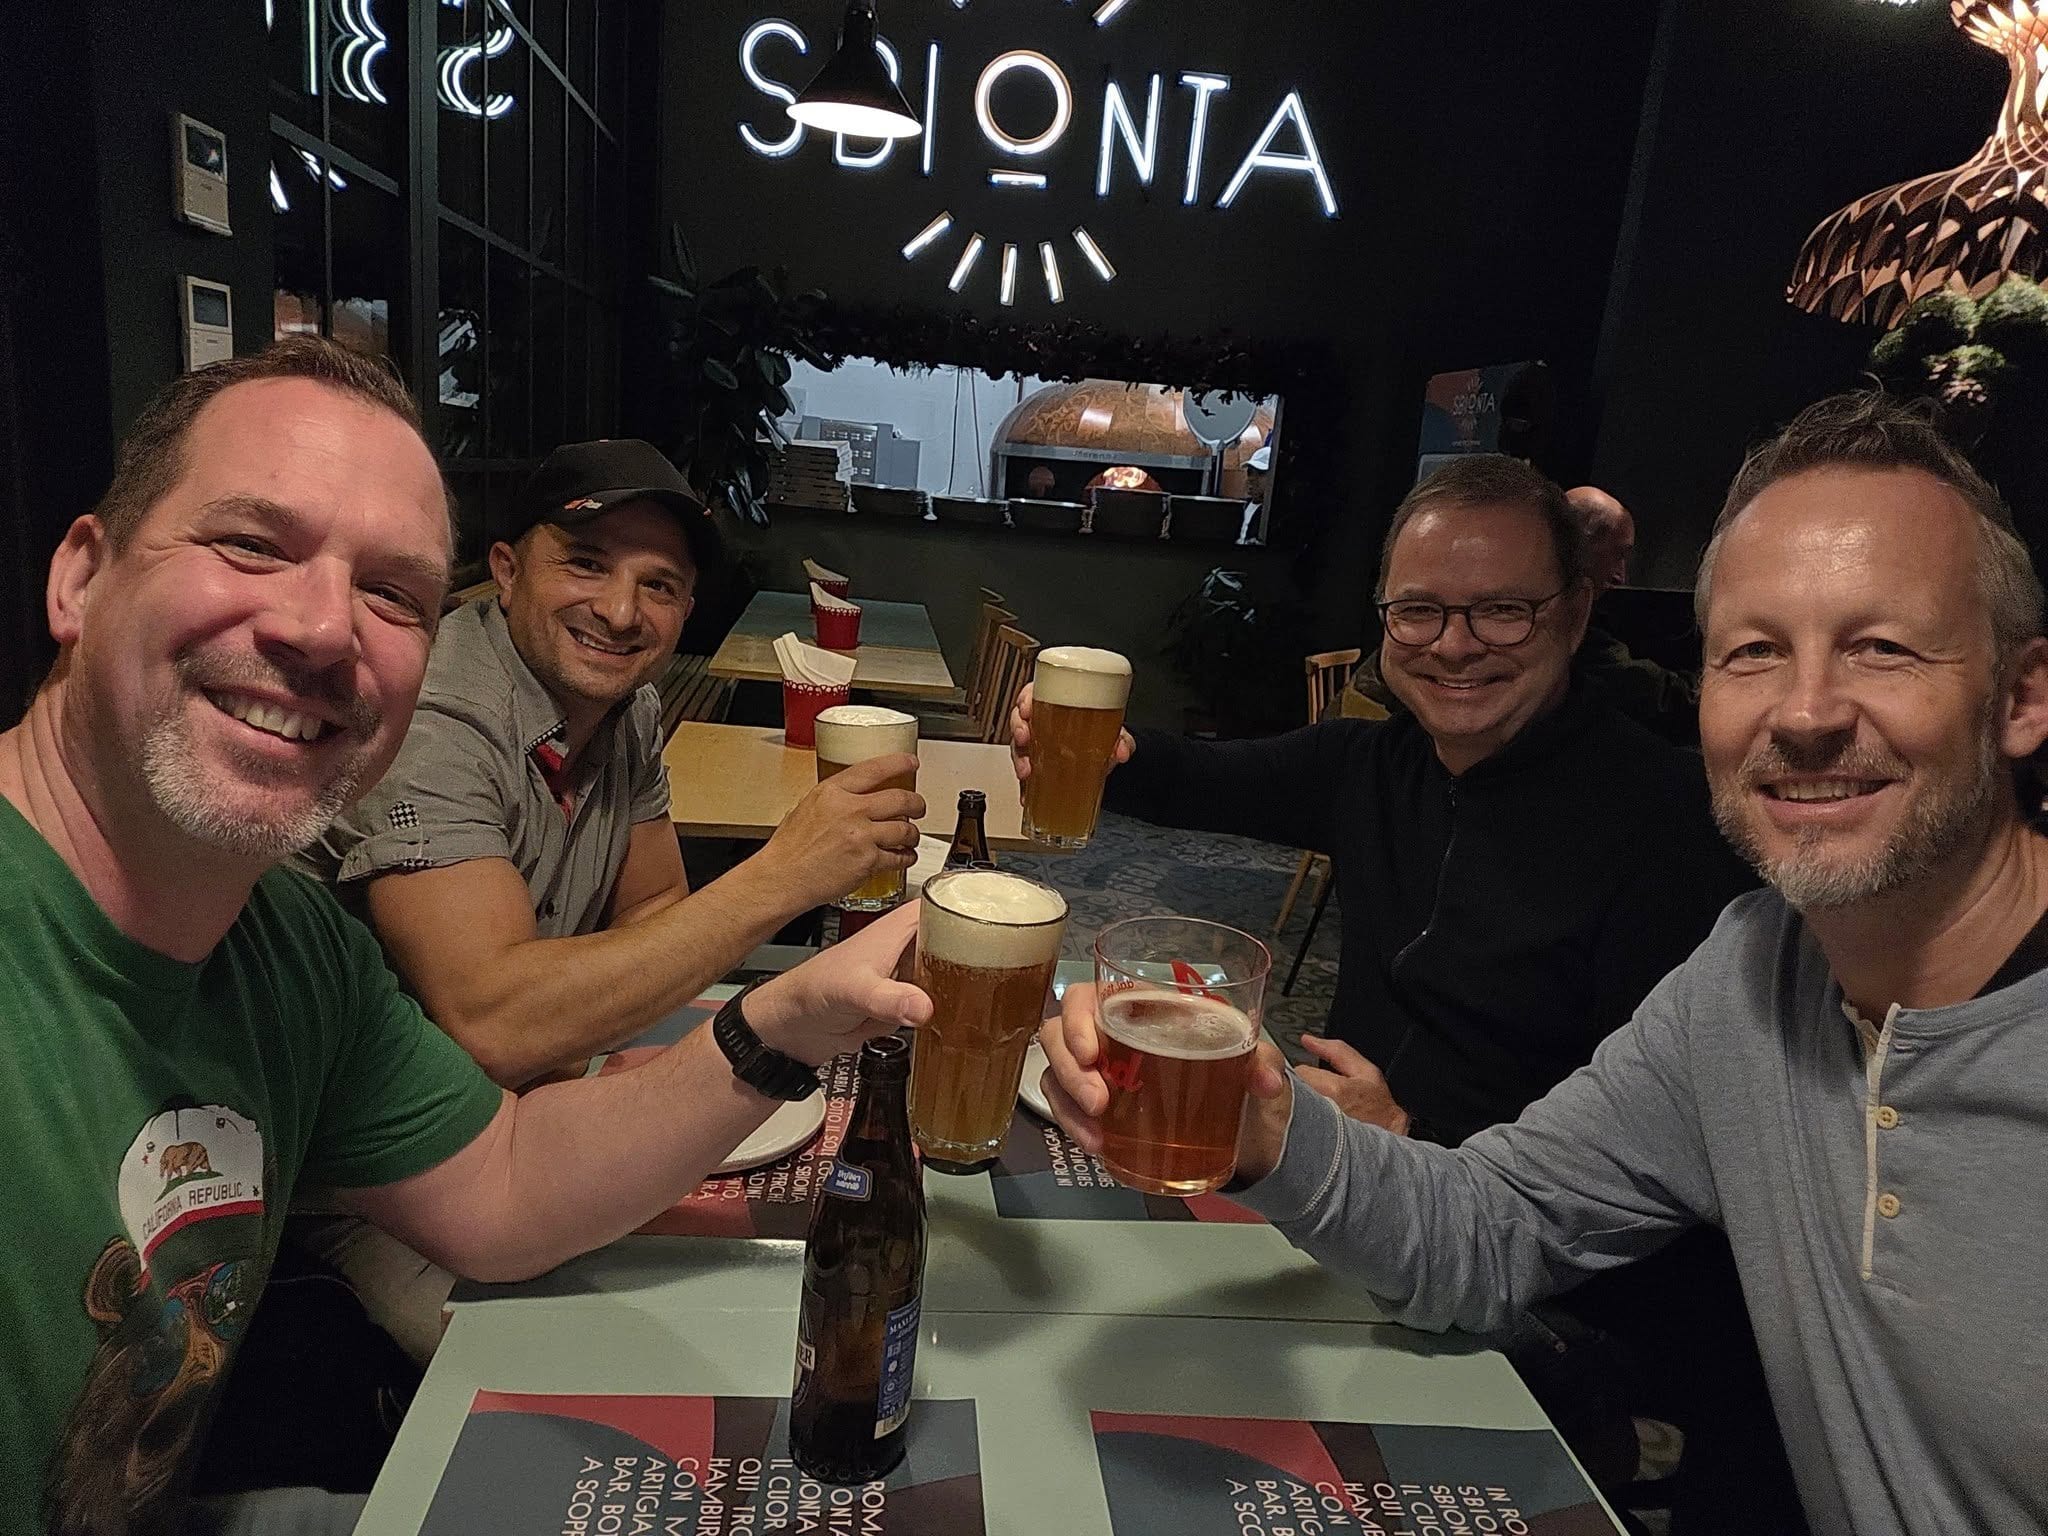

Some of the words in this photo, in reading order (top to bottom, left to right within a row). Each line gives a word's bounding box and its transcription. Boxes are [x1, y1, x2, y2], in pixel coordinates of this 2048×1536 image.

[828, 1096, 846, 1122] SOTTO
[1043, 1127, 1071, 1176] ROMAGNA
[1069, 1146, 1094, 1187] SBIONTA
[142, 1194, 183, 1240] CALIFORNIA
[188, 1181, 243, 1207] REPUBLIC
[578, 1455, 604, 1474] A
[604, 1456, 638, 1499] BAR,
[669, 1457, 700, 1502] CON
[735, 1457, 762, 1493] QUI
[769, 1457, 794, 1470] IL
[795, 1470, 823, 1534] IONTA
[1224, 1478, 1249, 1496] A
[1254, 1479, 1288, 1521] BAR,
[1314, 1480, 1351, 1525] CON
[1372, 1482, 1406, 1517] QUI
[1400, 1483, 1423, 1497] IL
[1485, 1487, 1512, 1502] IN
[861, 1480, 886, 1536] ROM
